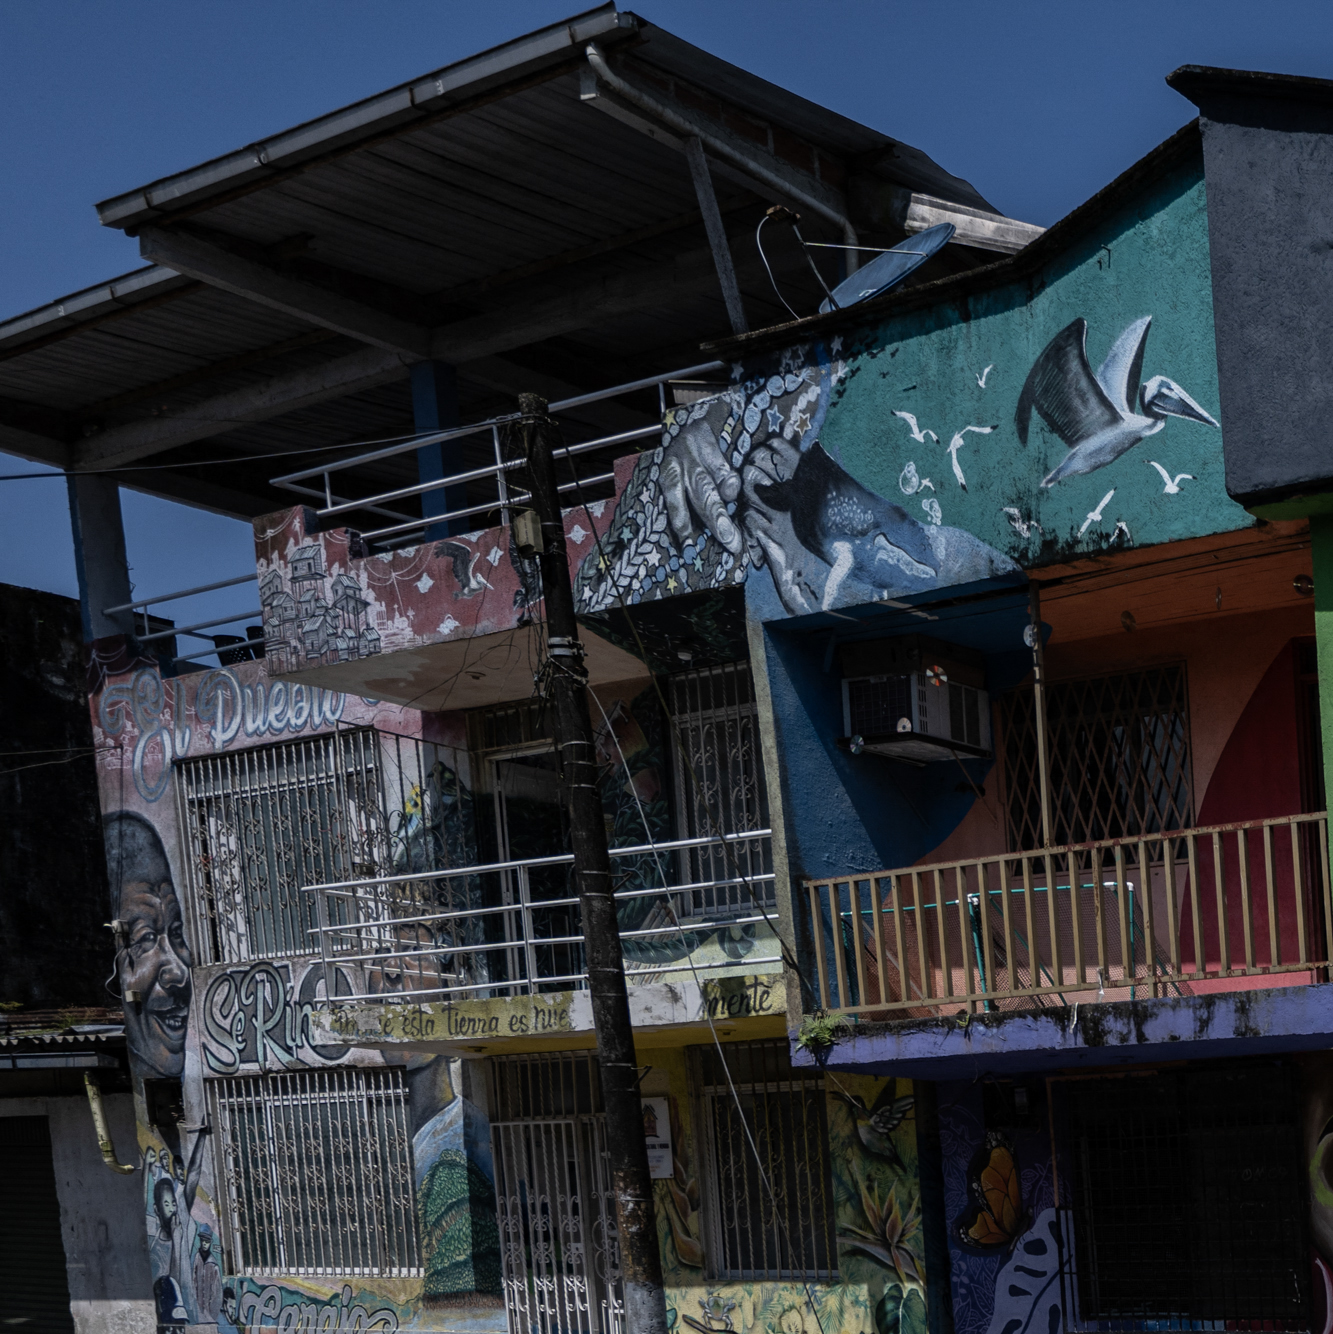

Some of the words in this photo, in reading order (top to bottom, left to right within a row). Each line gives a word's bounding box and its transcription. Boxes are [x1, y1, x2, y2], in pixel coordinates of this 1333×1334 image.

[100, 666, 191, 802] El
[402, 1004, 436, 1037] esta
[508, 1014, 530, 1034] es
